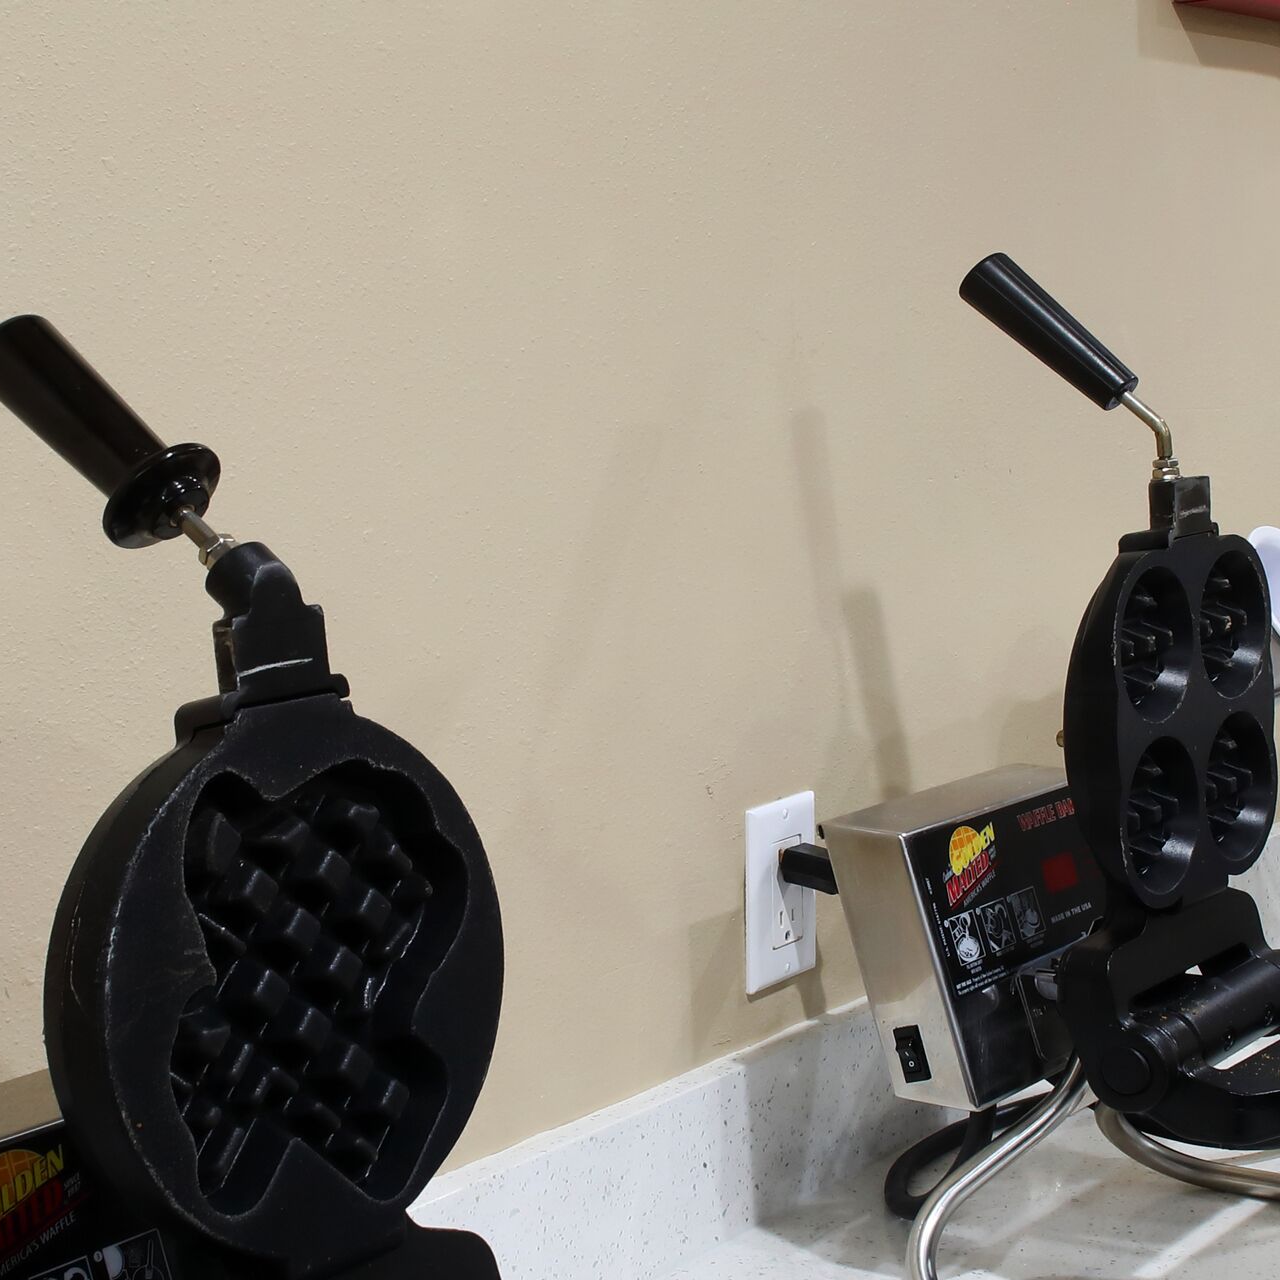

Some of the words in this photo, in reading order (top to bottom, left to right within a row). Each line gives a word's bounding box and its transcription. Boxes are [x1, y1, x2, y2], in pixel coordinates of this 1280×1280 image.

[945, 849, 990, 907] MALTED
[1071, 906, 1082, 917] THE
[1081, 902, 1092, 912] USA
[39, 1211, 77, 1245] WAFFLE
